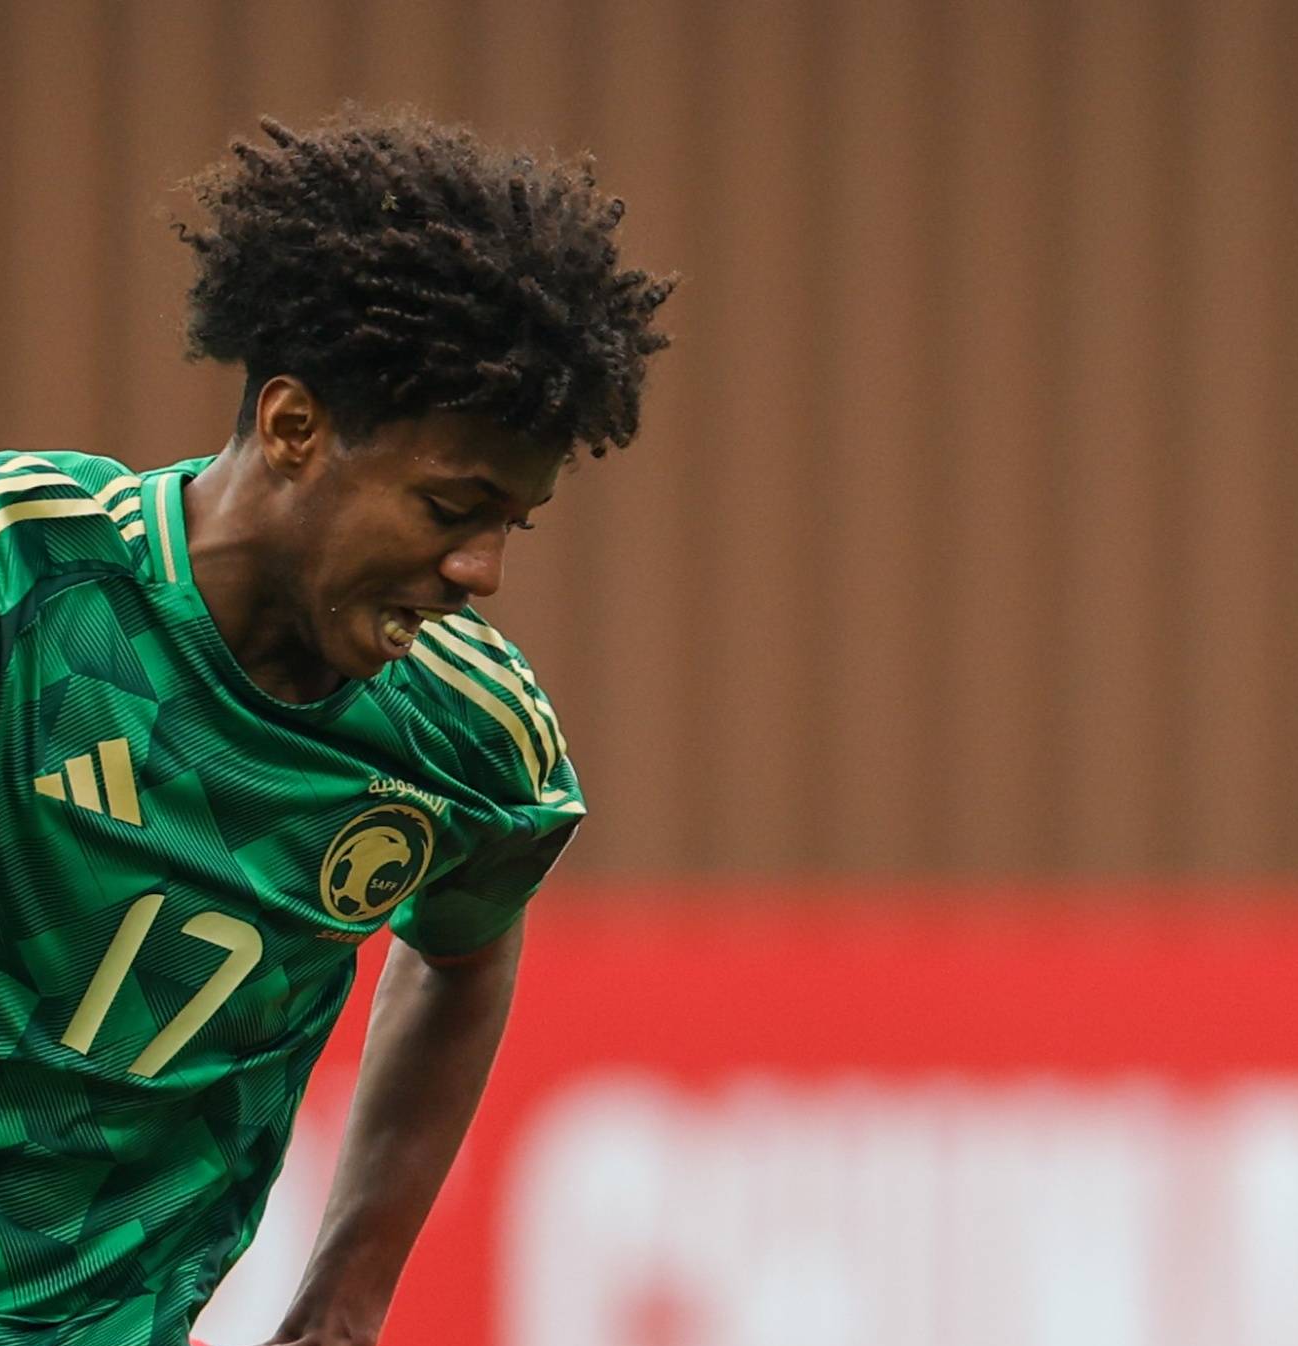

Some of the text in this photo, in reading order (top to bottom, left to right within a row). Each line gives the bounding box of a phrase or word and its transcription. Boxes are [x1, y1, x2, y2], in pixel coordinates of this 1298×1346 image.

[369, 775, 448, 817] السعودية
[369, 878, 398, 891] SAFF
[60, 893, 263, 1079] 17
